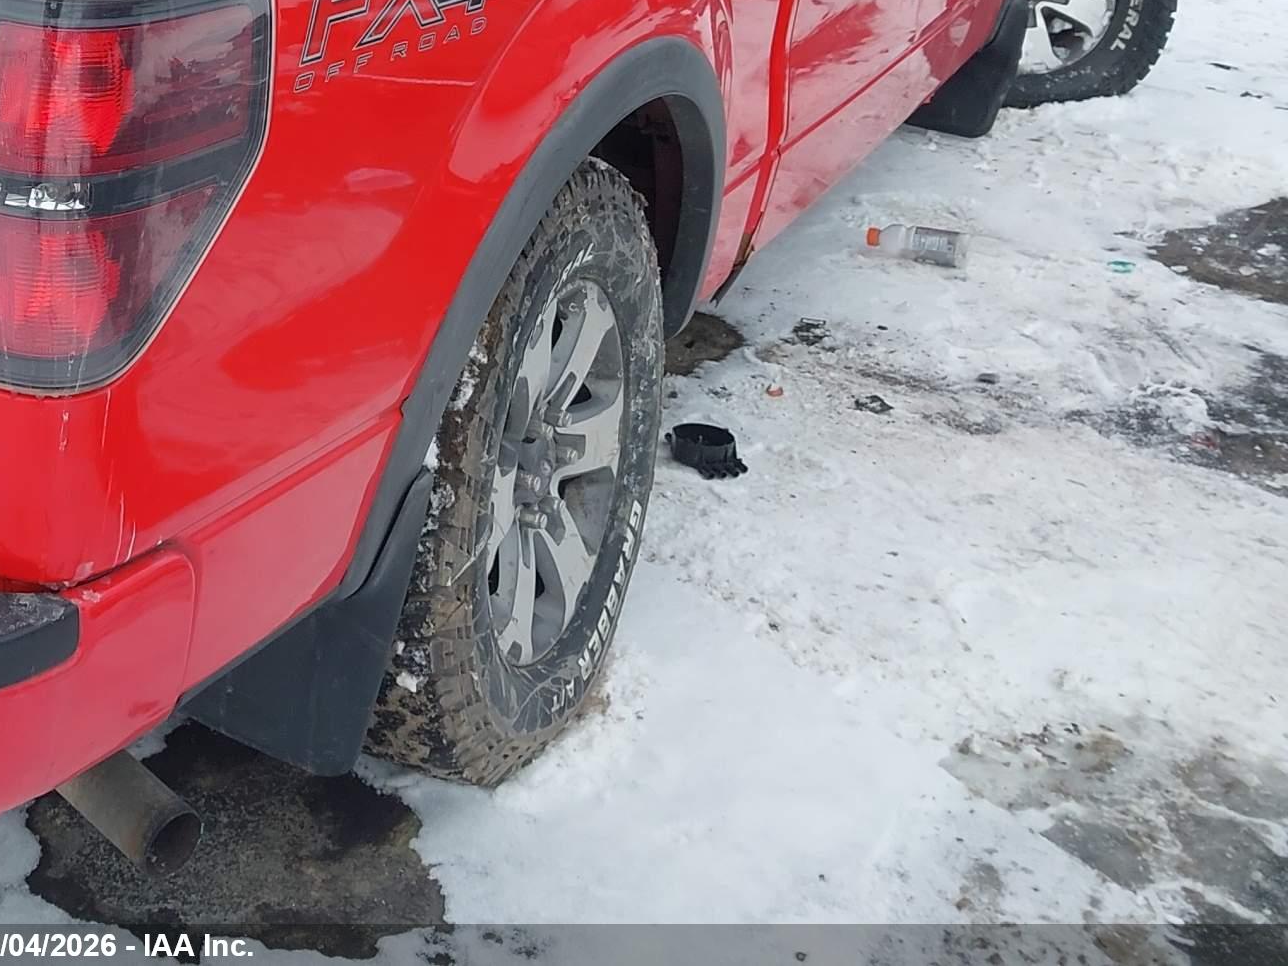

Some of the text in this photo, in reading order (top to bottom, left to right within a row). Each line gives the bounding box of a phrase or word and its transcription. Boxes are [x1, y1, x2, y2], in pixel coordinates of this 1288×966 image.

[293, 17, 488, 94] OFF ROAD
[577, 499, 643, 682] GRABBER
